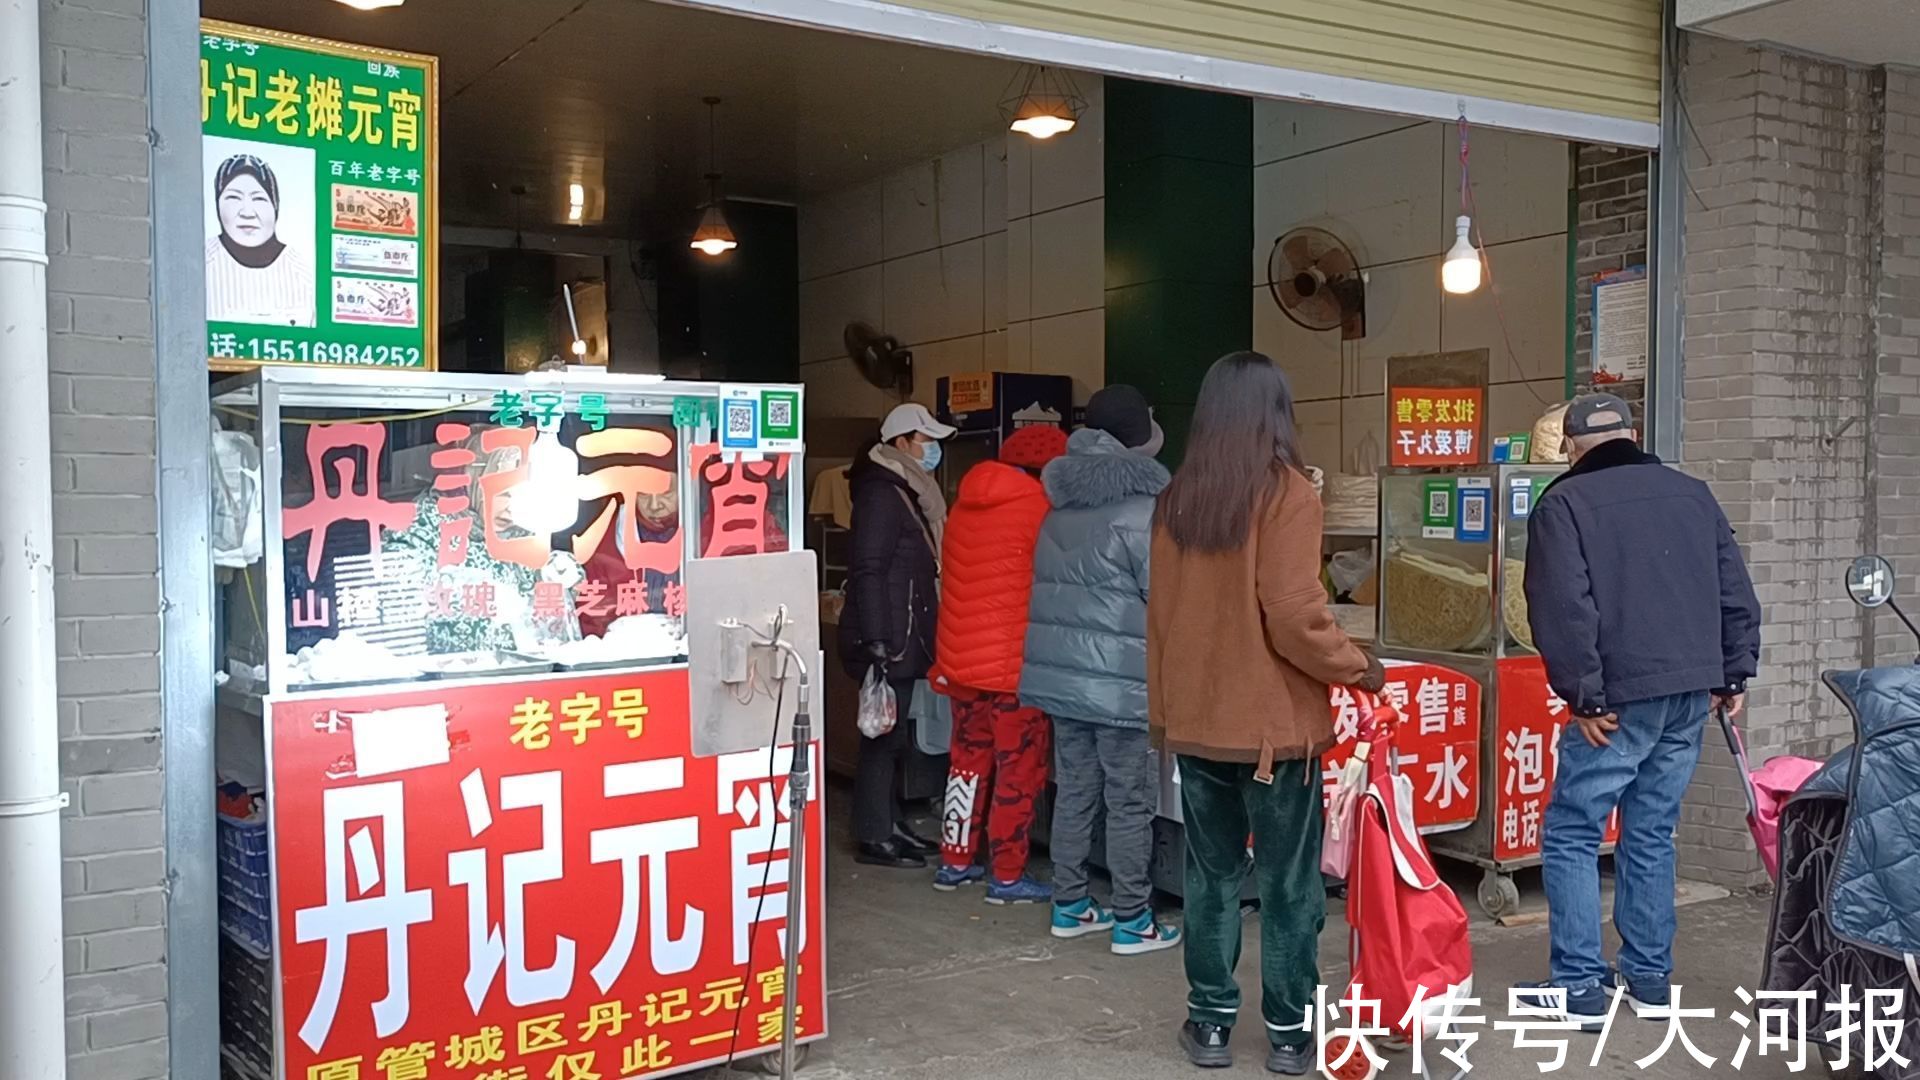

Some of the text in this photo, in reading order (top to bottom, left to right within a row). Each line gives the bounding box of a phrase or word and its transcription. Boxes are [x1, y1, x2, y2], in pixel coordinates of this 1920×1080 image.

[328, 160, 421, 186] 百年老字号
[489, 389, 610, 431] 老字号
[533, 580, 648, 618] 黑芝麻
[510, 688, 650, 749] 老字号
[1453, 683, 1467, 726] 回族
[1503, 722, 1560, 797] 泡
[1503, 799, 1540, 850] 电话
[296, 744, 818, 1054] 丹记元宵
